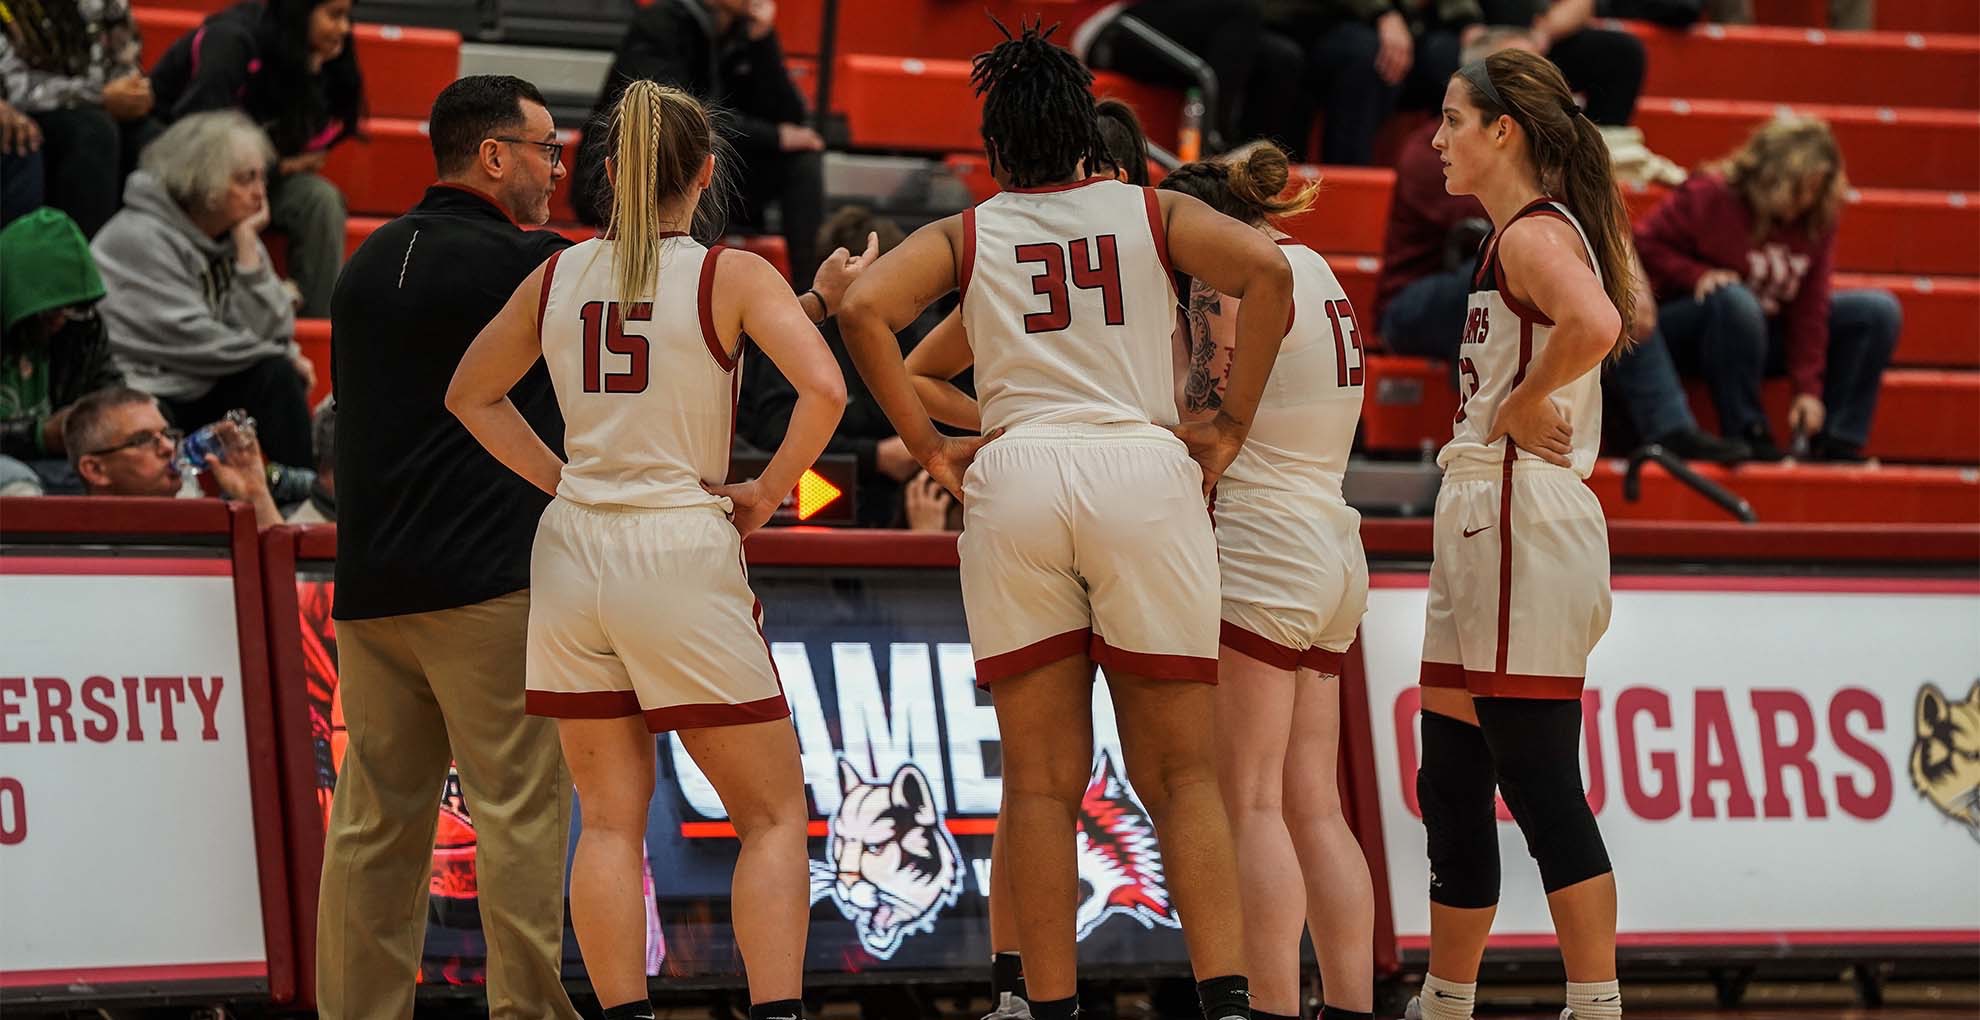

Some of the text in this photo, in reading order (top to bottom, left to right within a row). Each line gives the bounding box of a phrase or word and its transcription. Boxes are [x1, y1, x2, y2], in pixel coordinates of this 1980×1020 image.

[1014, 234, 1125, 334] 34
[580, 301, 654, 393] 15
[1325, 299, 1364, 387] 13
[0, 676, 224, 743] ERSITY
[667, 641, 1003, 819] AME
